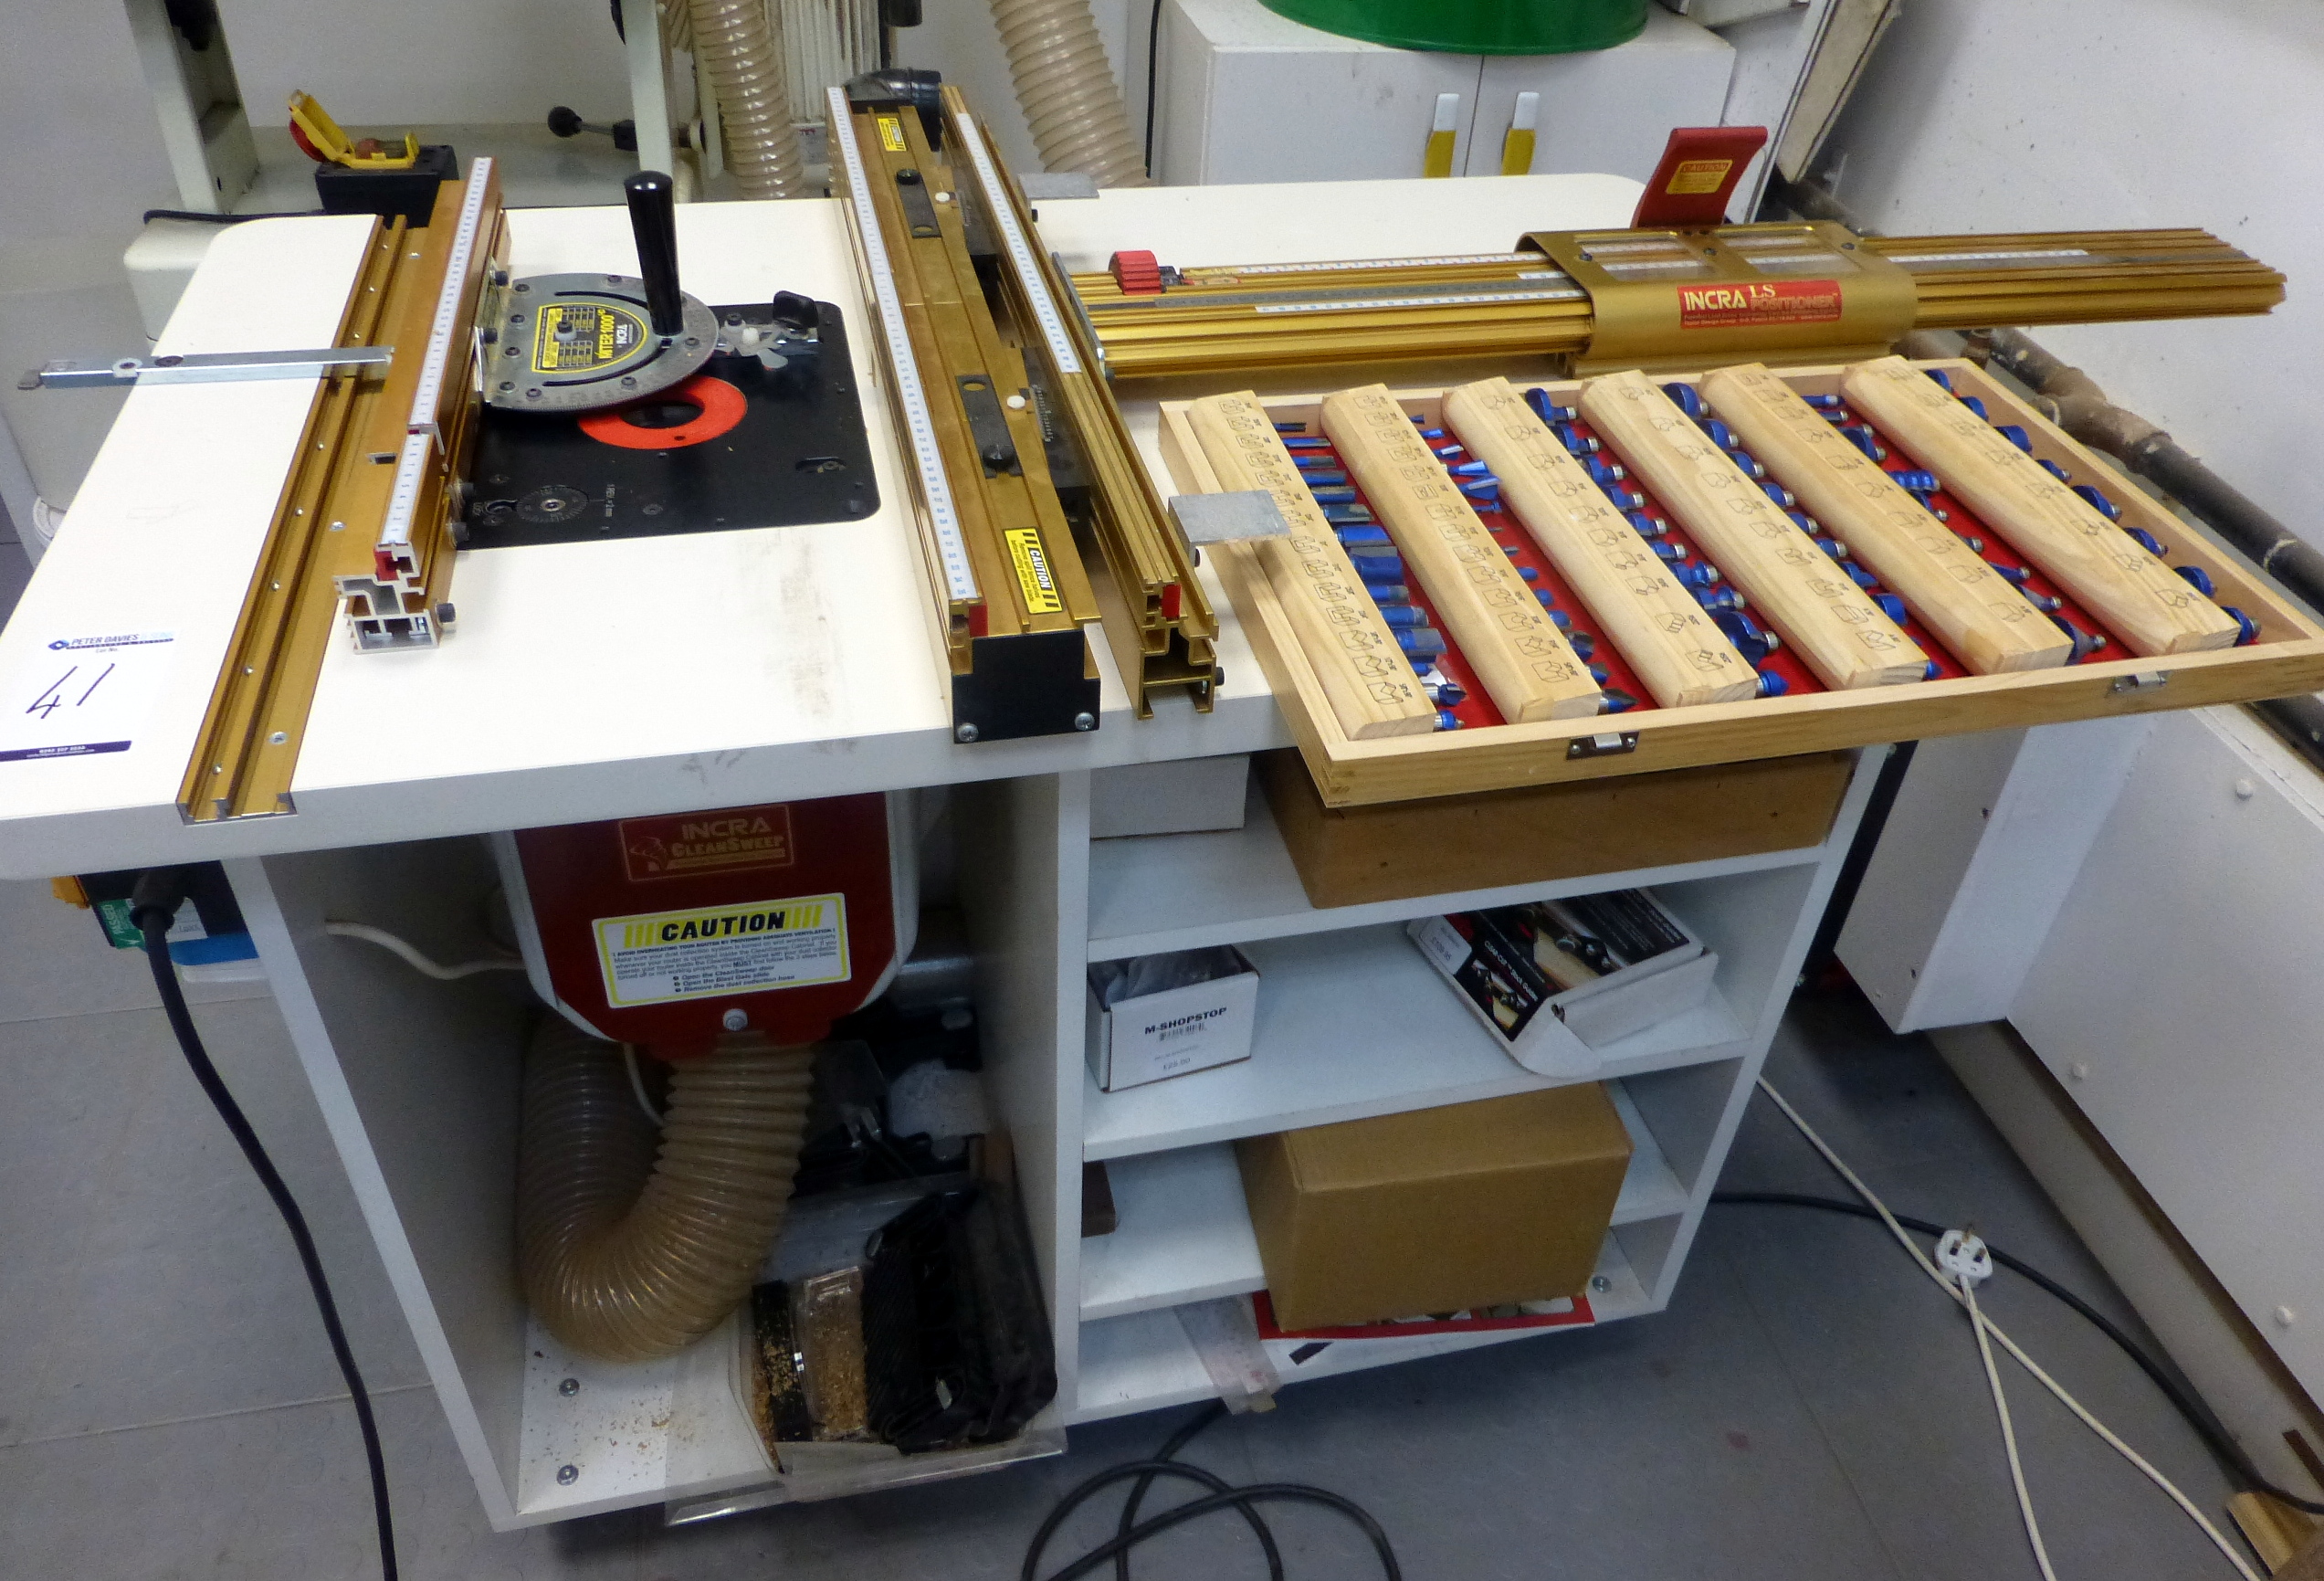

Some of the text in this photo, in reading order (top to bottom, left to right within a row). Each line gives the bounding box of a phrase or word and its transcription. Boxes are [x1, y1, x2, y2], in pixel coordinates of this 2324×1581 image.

[1684, 284, 1776, 311] INCRA LS
[600, 314, 615, 333] 1000
[616, 324, 628, 344] INCRA
[1029, 550, 1050, 588] CAUTION
[72, 637, 102, 645] PETER
[104, 634, 140, 643] DAVIES
[681, 817, 772, 839] INCRA
[662, 911, 785, 942] CAUTION
[1144, 1007, 1227, 1035] M-SHOPSTOP
